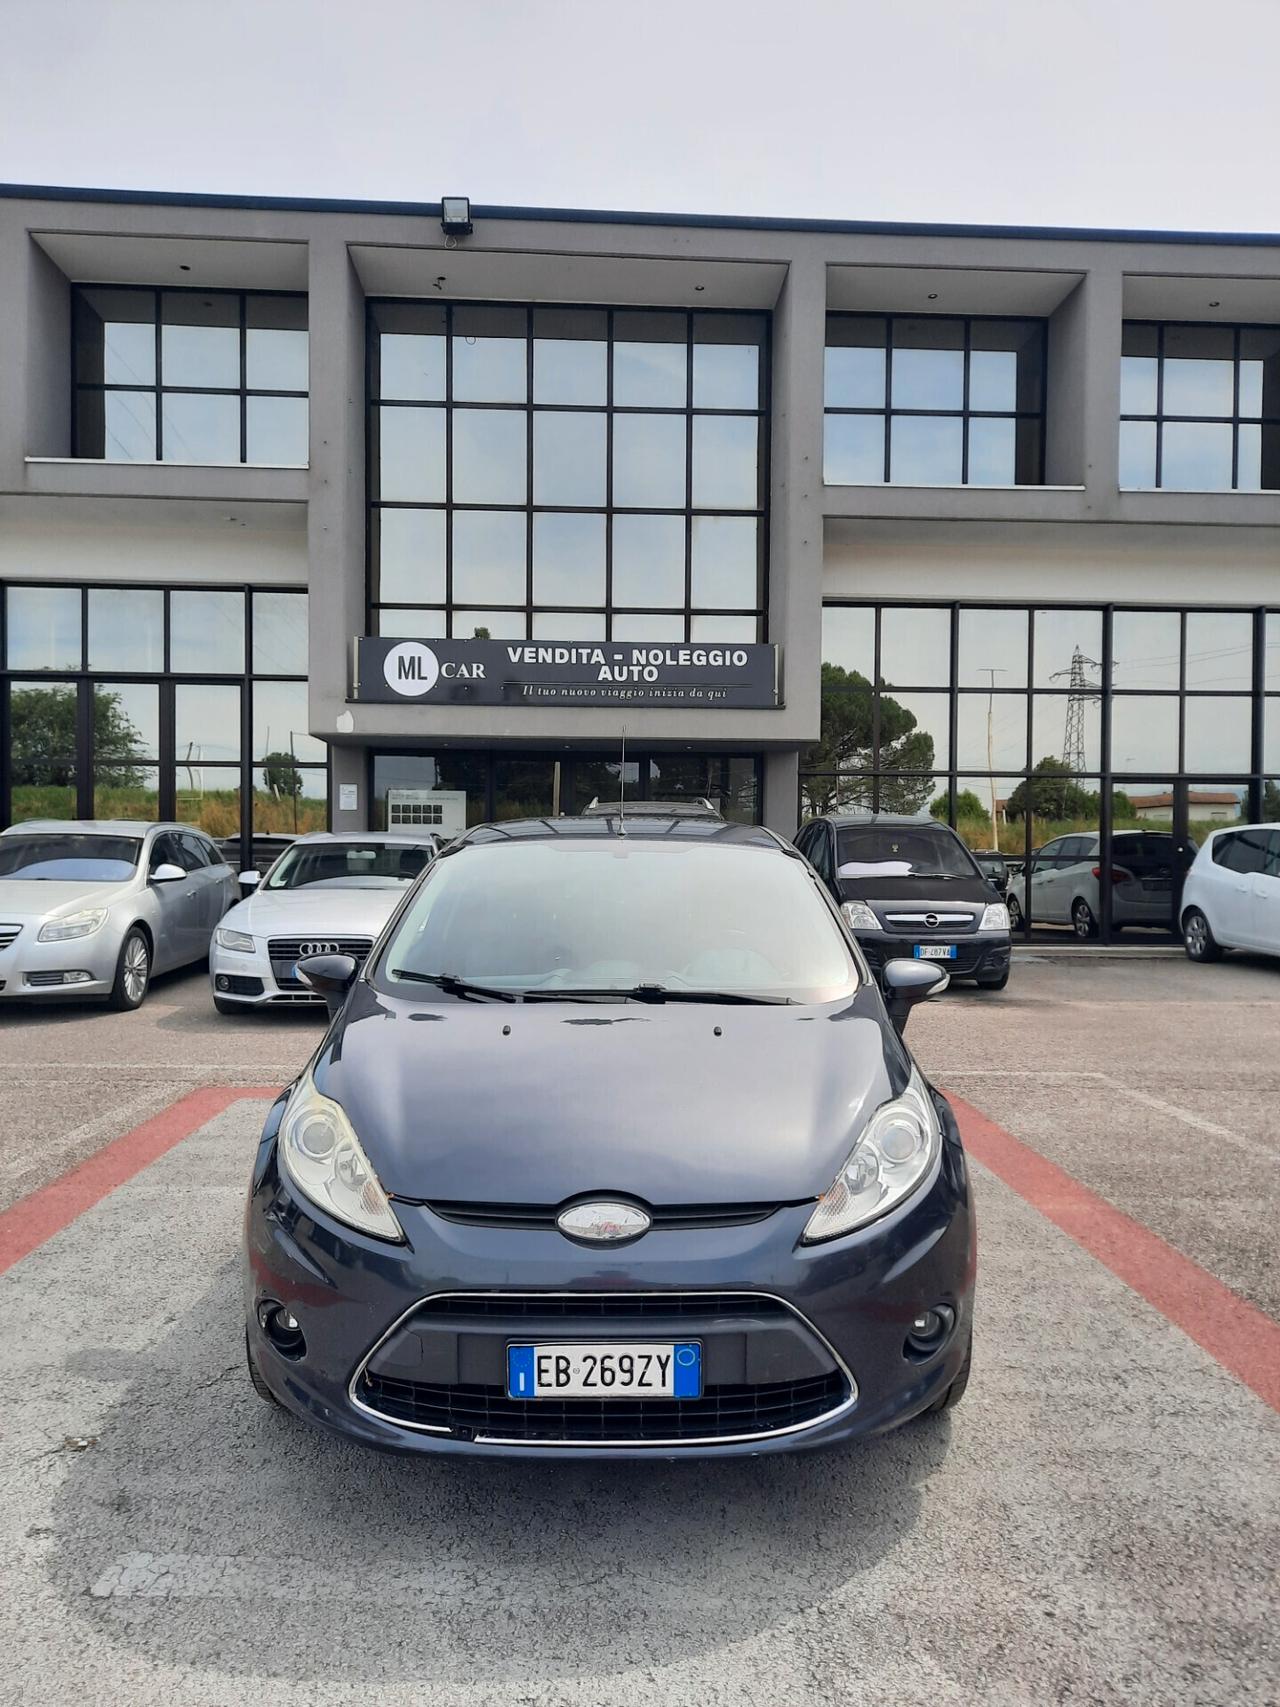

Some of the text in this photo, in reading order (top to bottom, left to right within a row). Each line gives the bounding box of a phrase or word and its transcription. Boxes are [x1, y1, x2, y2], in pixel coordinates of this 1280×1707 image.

[507, 647, 606, 664] VENDITA
[632, 649, 748, 666] NOLEGGIO
[398, 655, 486, 680] ML CAR
[598, 665, 659, 682] AUTO
[523, 685, 728, 700] Il tuo nuovo viaggio inizia da qui
[537, 1355, 571, 1387] EB
[582, 1355, 671, 1387] 269ZY
